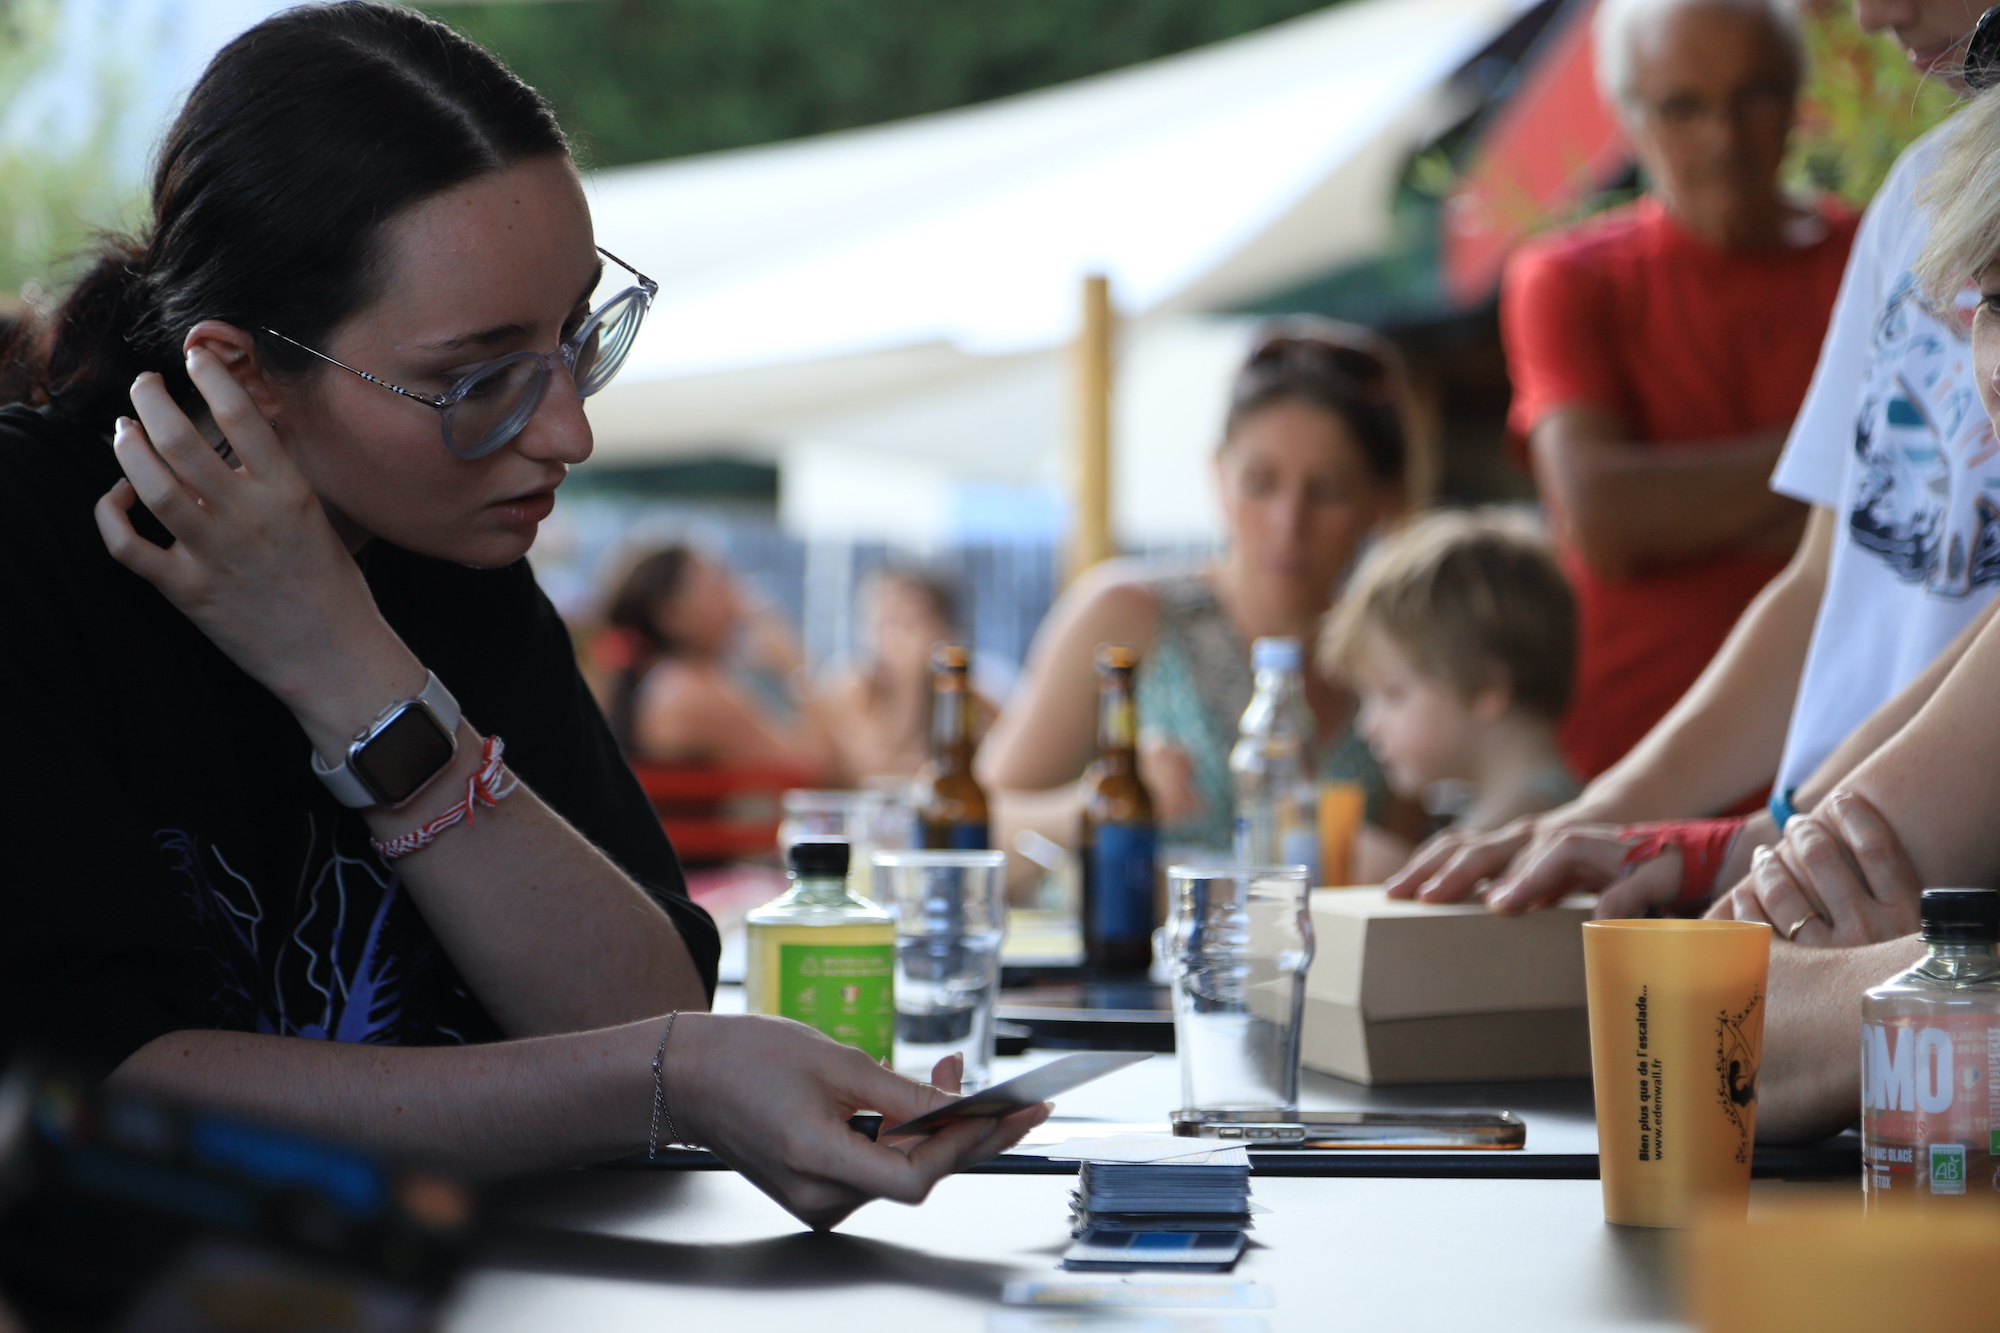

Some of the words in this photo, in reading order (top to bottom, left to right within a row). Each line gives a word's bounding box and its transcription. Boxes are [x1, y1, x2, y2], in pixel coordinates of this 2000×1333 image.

[1637, 1061, 1648, 1076] de
[1640, 1080, 1651, 1102] que
[1639, 1105, 1651, 1131] plus
[1652, 1059, 1662, 1160] www.edenwall.fr
[1638, 1134, 1649, 1161] Bien
[1888, 1147, 1914, 1162] GLACÉ
[1934, 1162, 1958, 1179] AB
